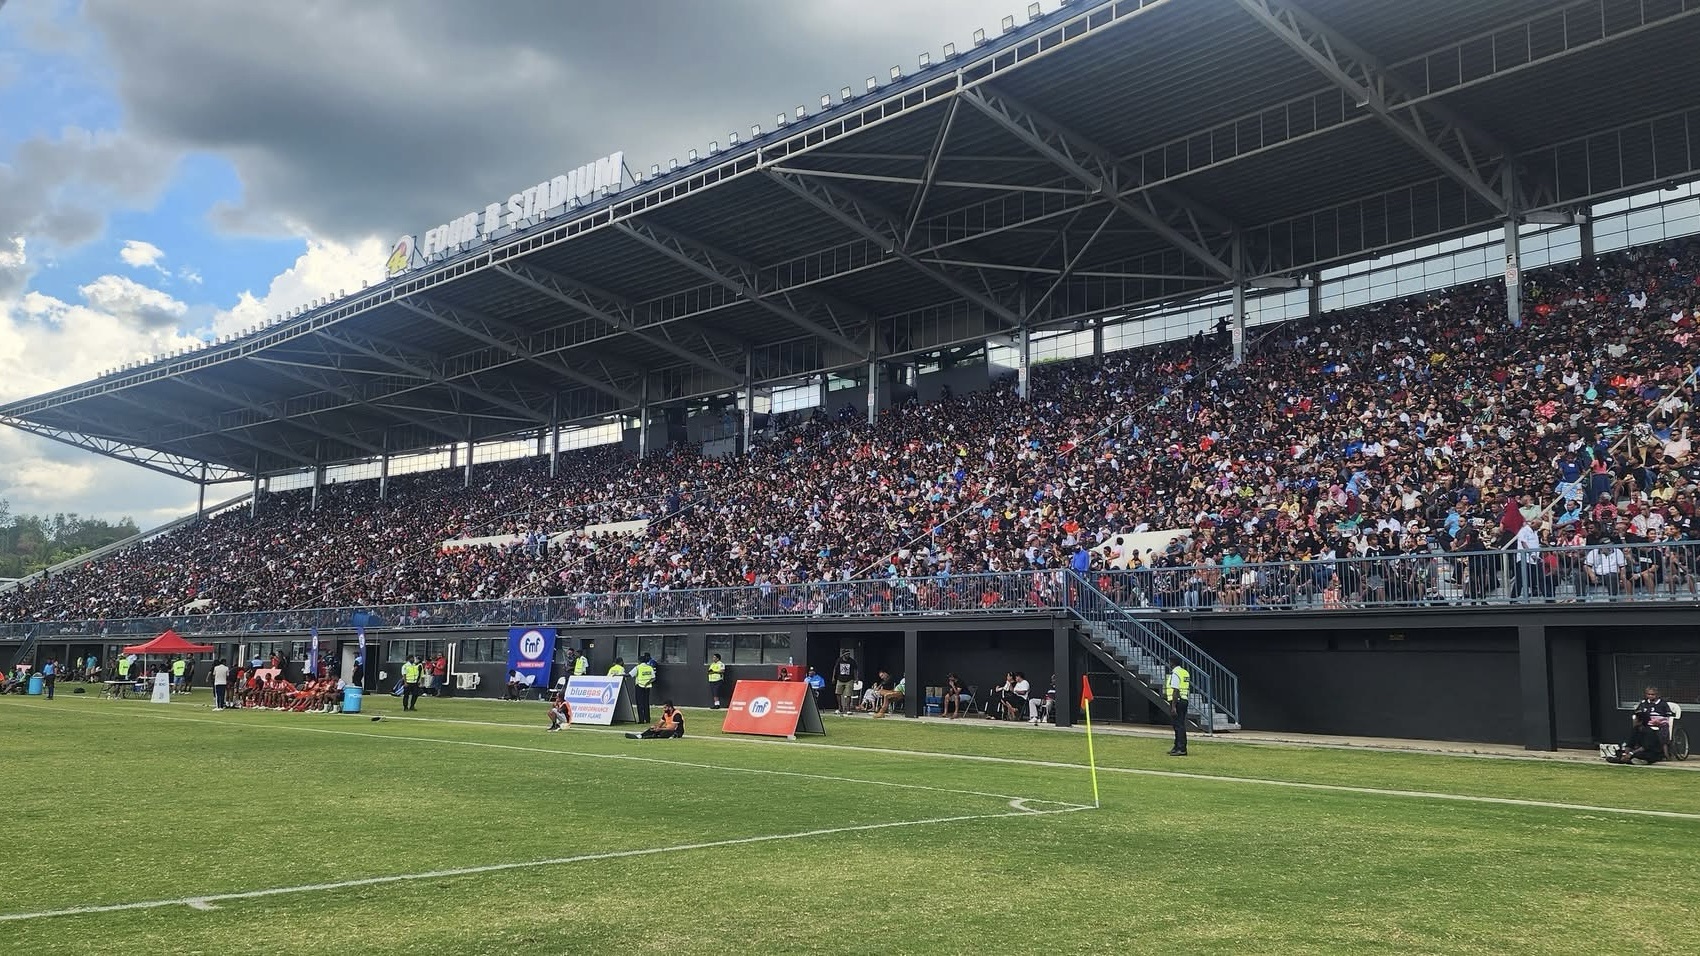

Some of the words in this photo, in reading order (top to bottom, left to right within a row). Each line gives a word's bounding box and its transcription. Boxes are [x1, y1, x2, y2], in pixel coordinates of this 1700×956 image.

[423, 212, 479, 259] FOUR
[506, 151, 624, 225] STADIUM
[1506, 255, 1513, 263] F
[524, 637, 541, 653] fmf
[570, 687, 601, 698] bluegas
[752, 701, 769, 713] fmf
